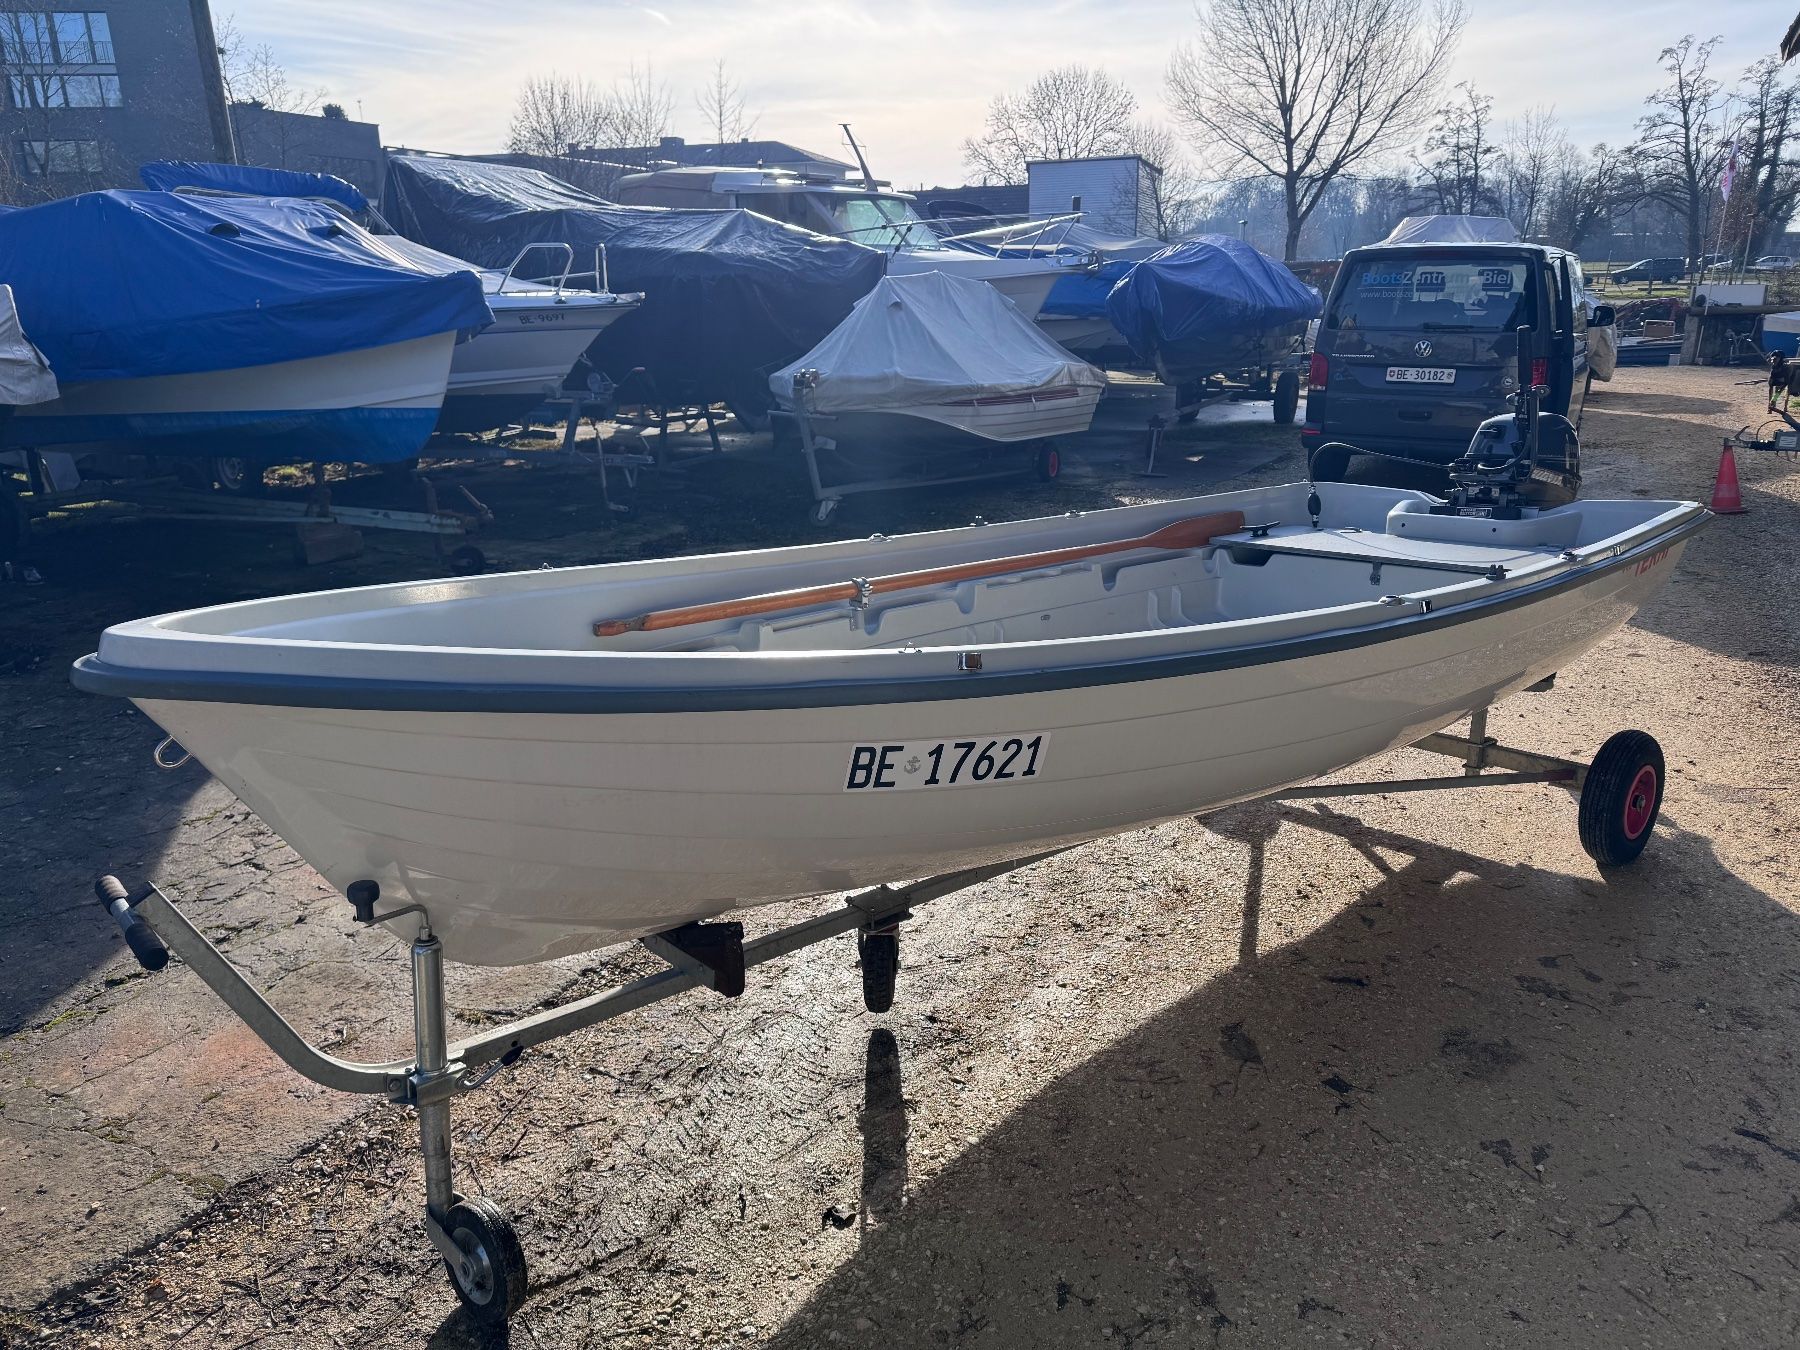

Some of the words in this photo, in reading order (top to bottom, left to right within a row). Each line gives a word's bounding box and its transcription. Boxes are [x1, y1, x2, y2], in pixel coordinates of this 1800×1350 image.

[1483, 270, 1511, 284] Biel
[846, 745, 904, 789] BE
[924, 735, 1043, 786] 17621
